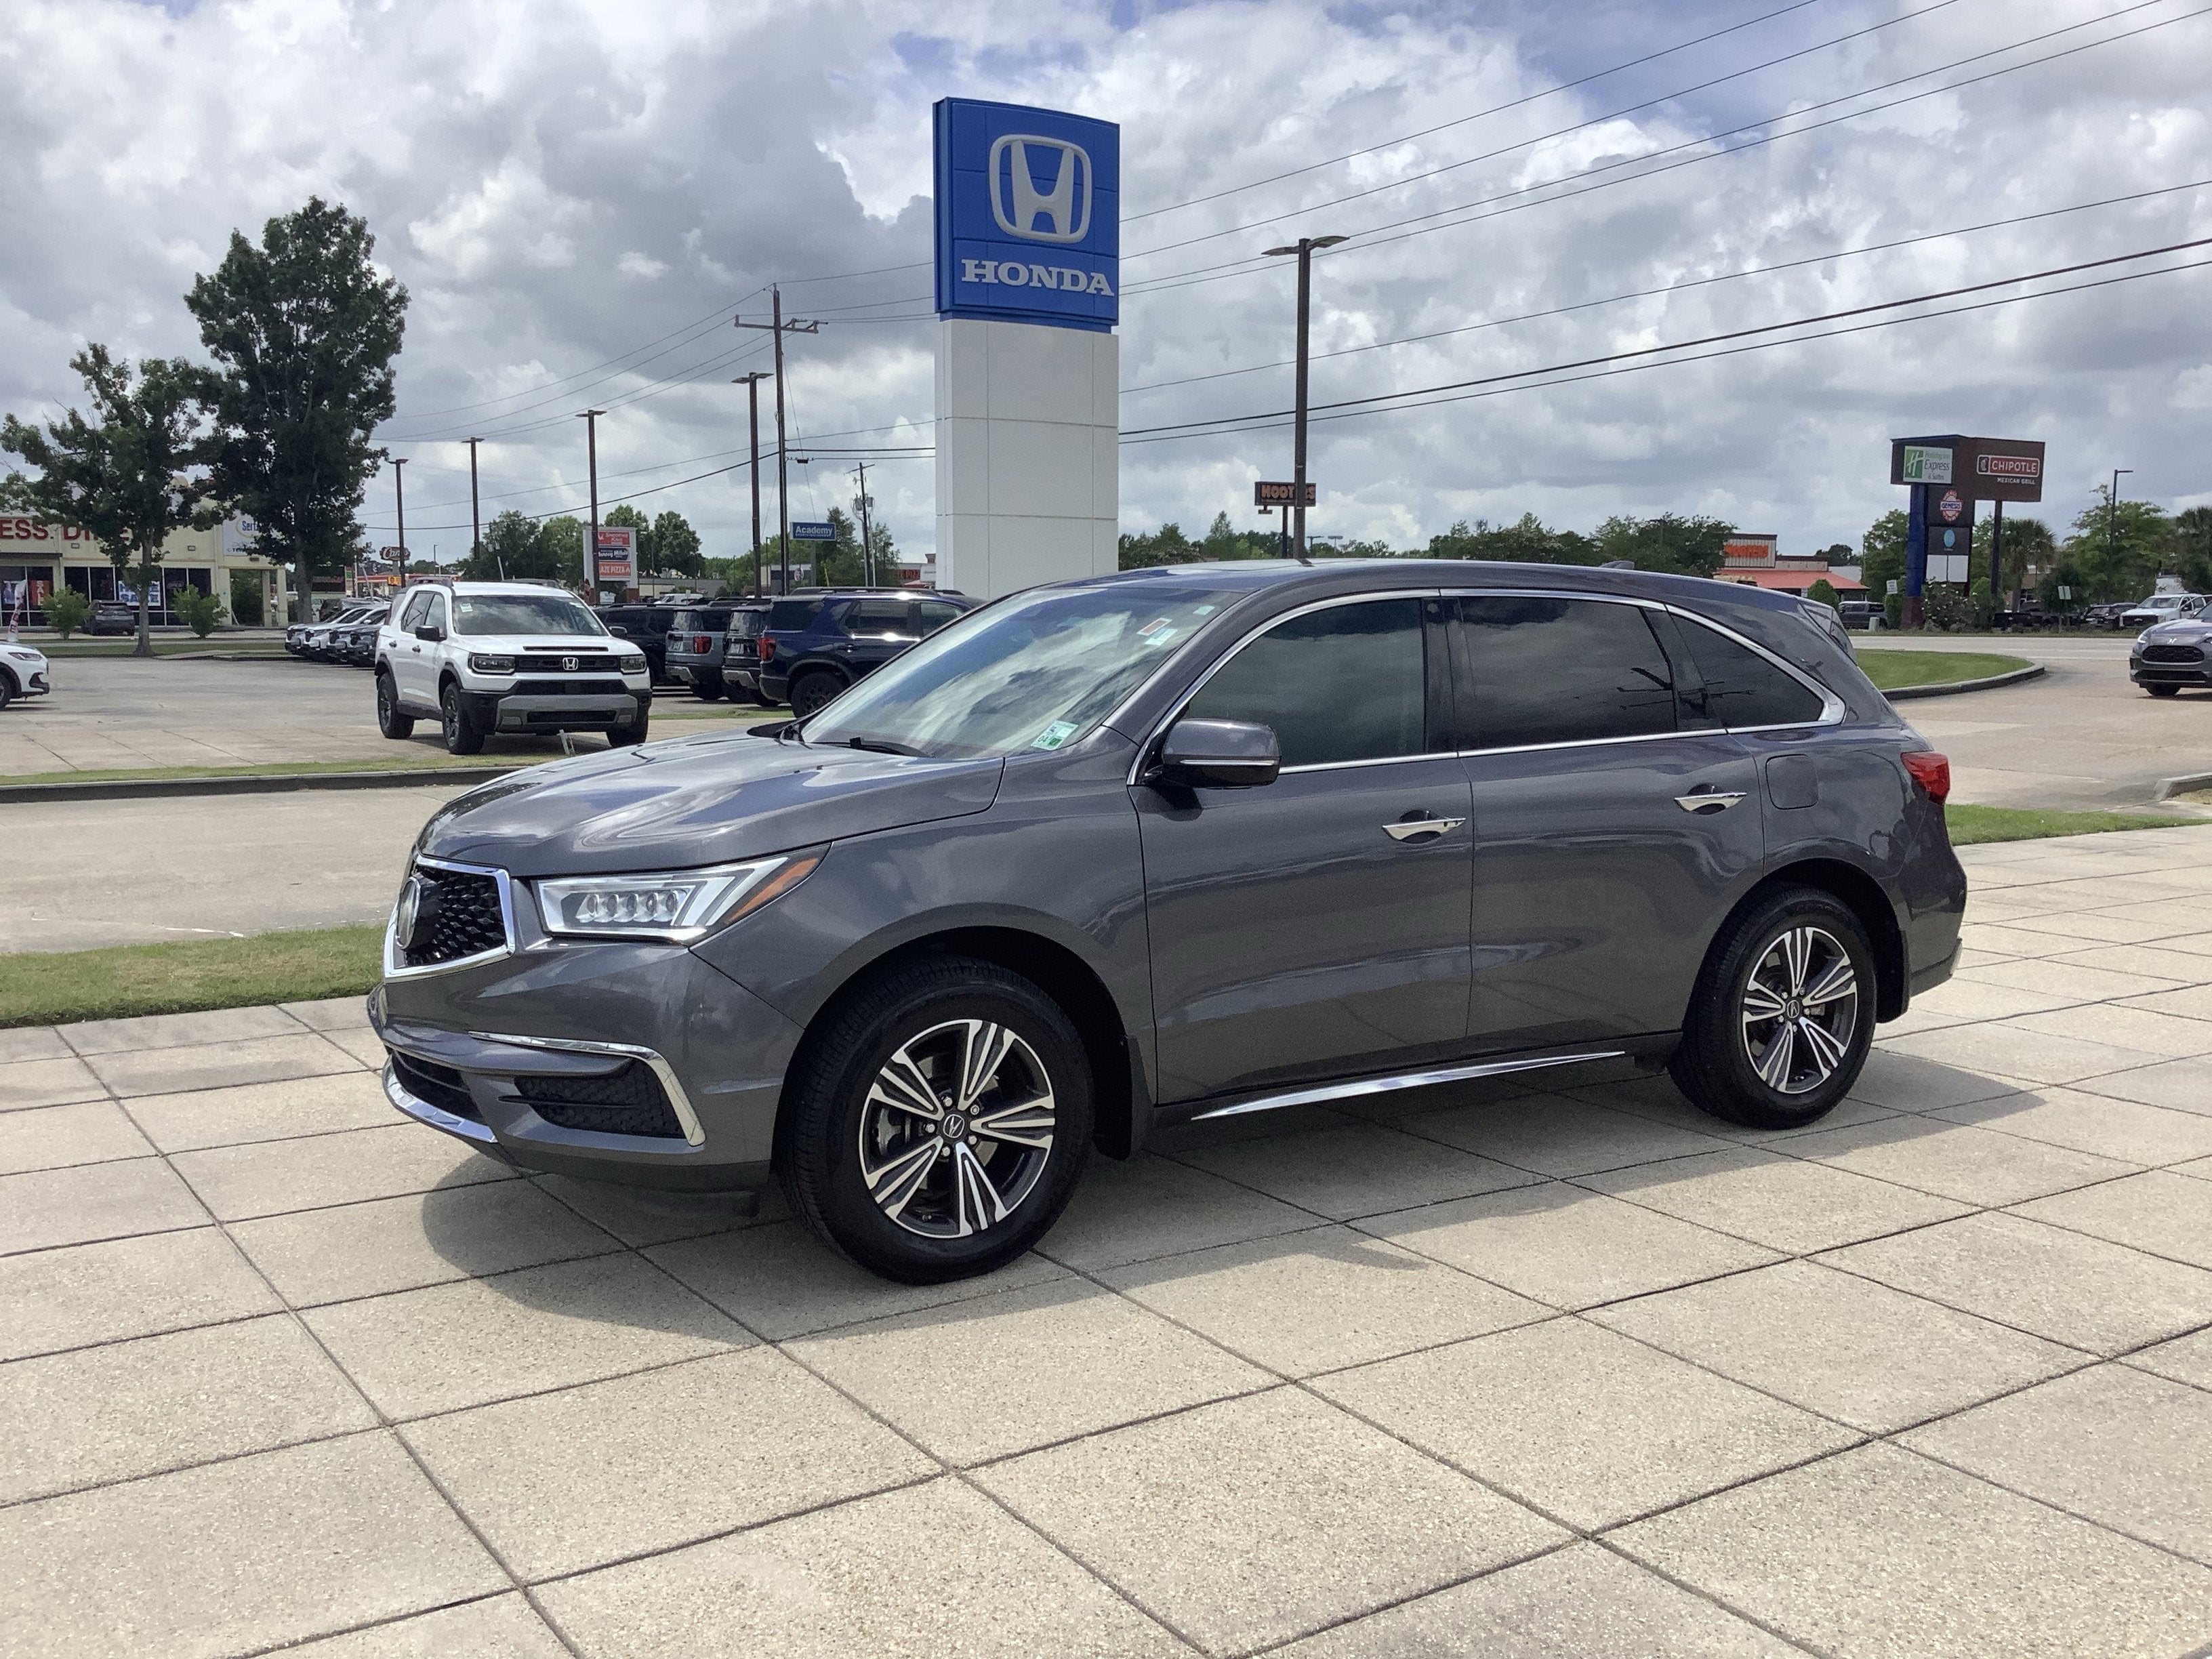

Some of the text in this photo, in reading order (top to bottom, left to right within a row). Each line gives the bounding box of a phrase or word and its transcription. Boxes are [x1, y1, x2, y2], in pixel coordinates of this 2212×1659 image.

[961, 259, 1115, 296] HONDA
[1925, 459, 1950, 472] Express
[1992, 460, 2037, 472] CHIPOTLE
[1261, 485, 1315, 499] HOOTS
[242, 520, 258, 531] Sert
[796, 526, 833, 536] Academy
